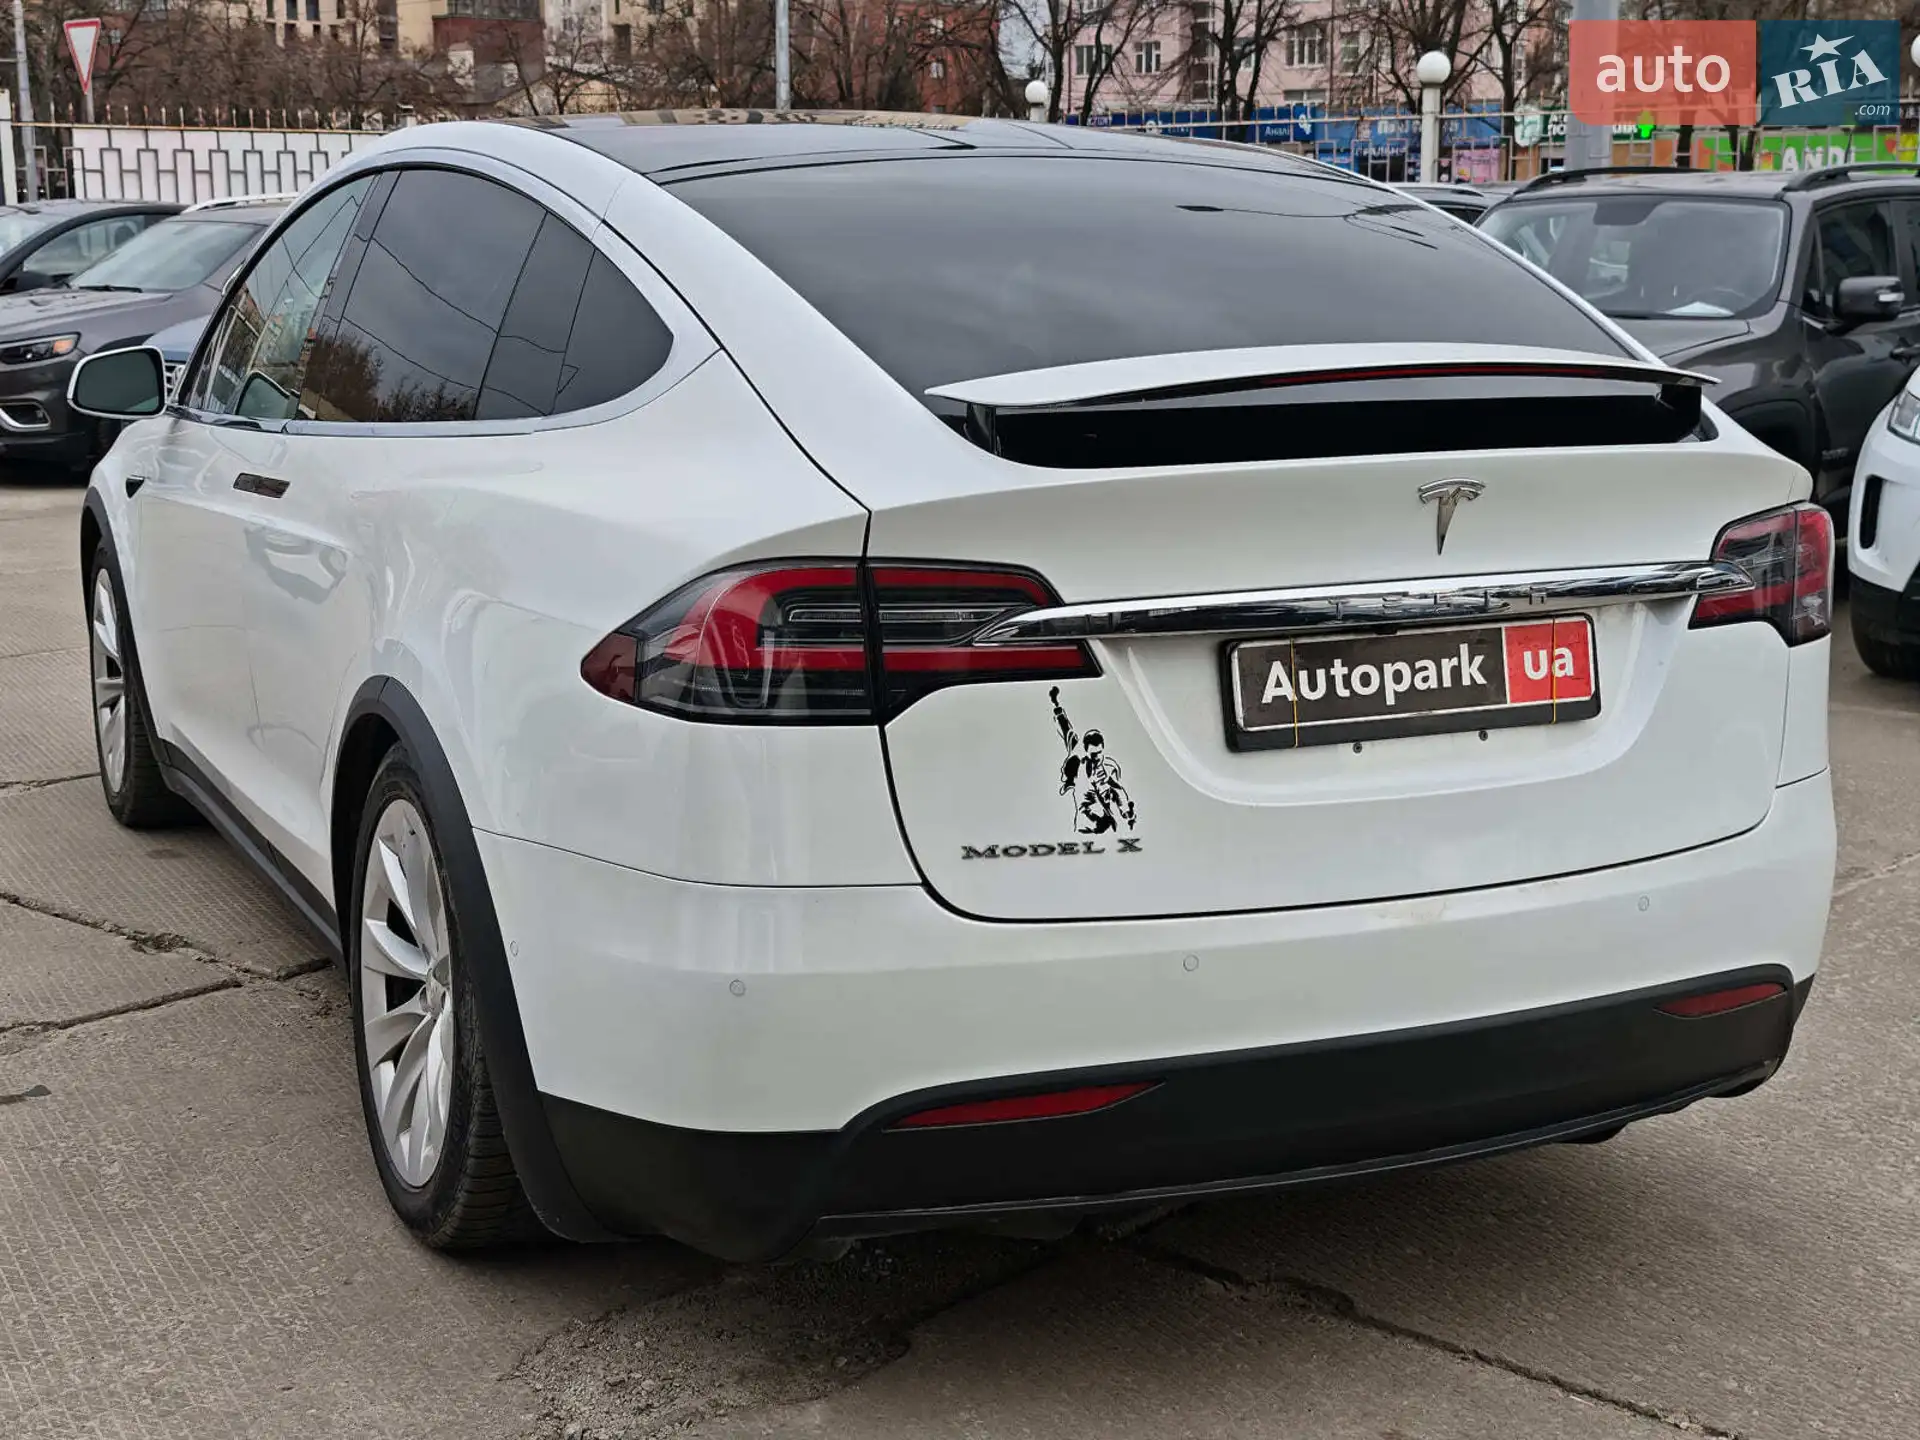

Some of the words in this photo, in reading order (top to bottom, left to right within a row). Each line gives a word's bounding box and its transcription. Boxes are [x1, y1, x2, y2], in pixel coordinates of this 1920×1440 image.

[1261, 643, 1488, 706] Autopark
[1523, 646, 1575, 681] ua
[961, 841, 1106, 860] MODEL
[1117, 838, 1143, 853] X
